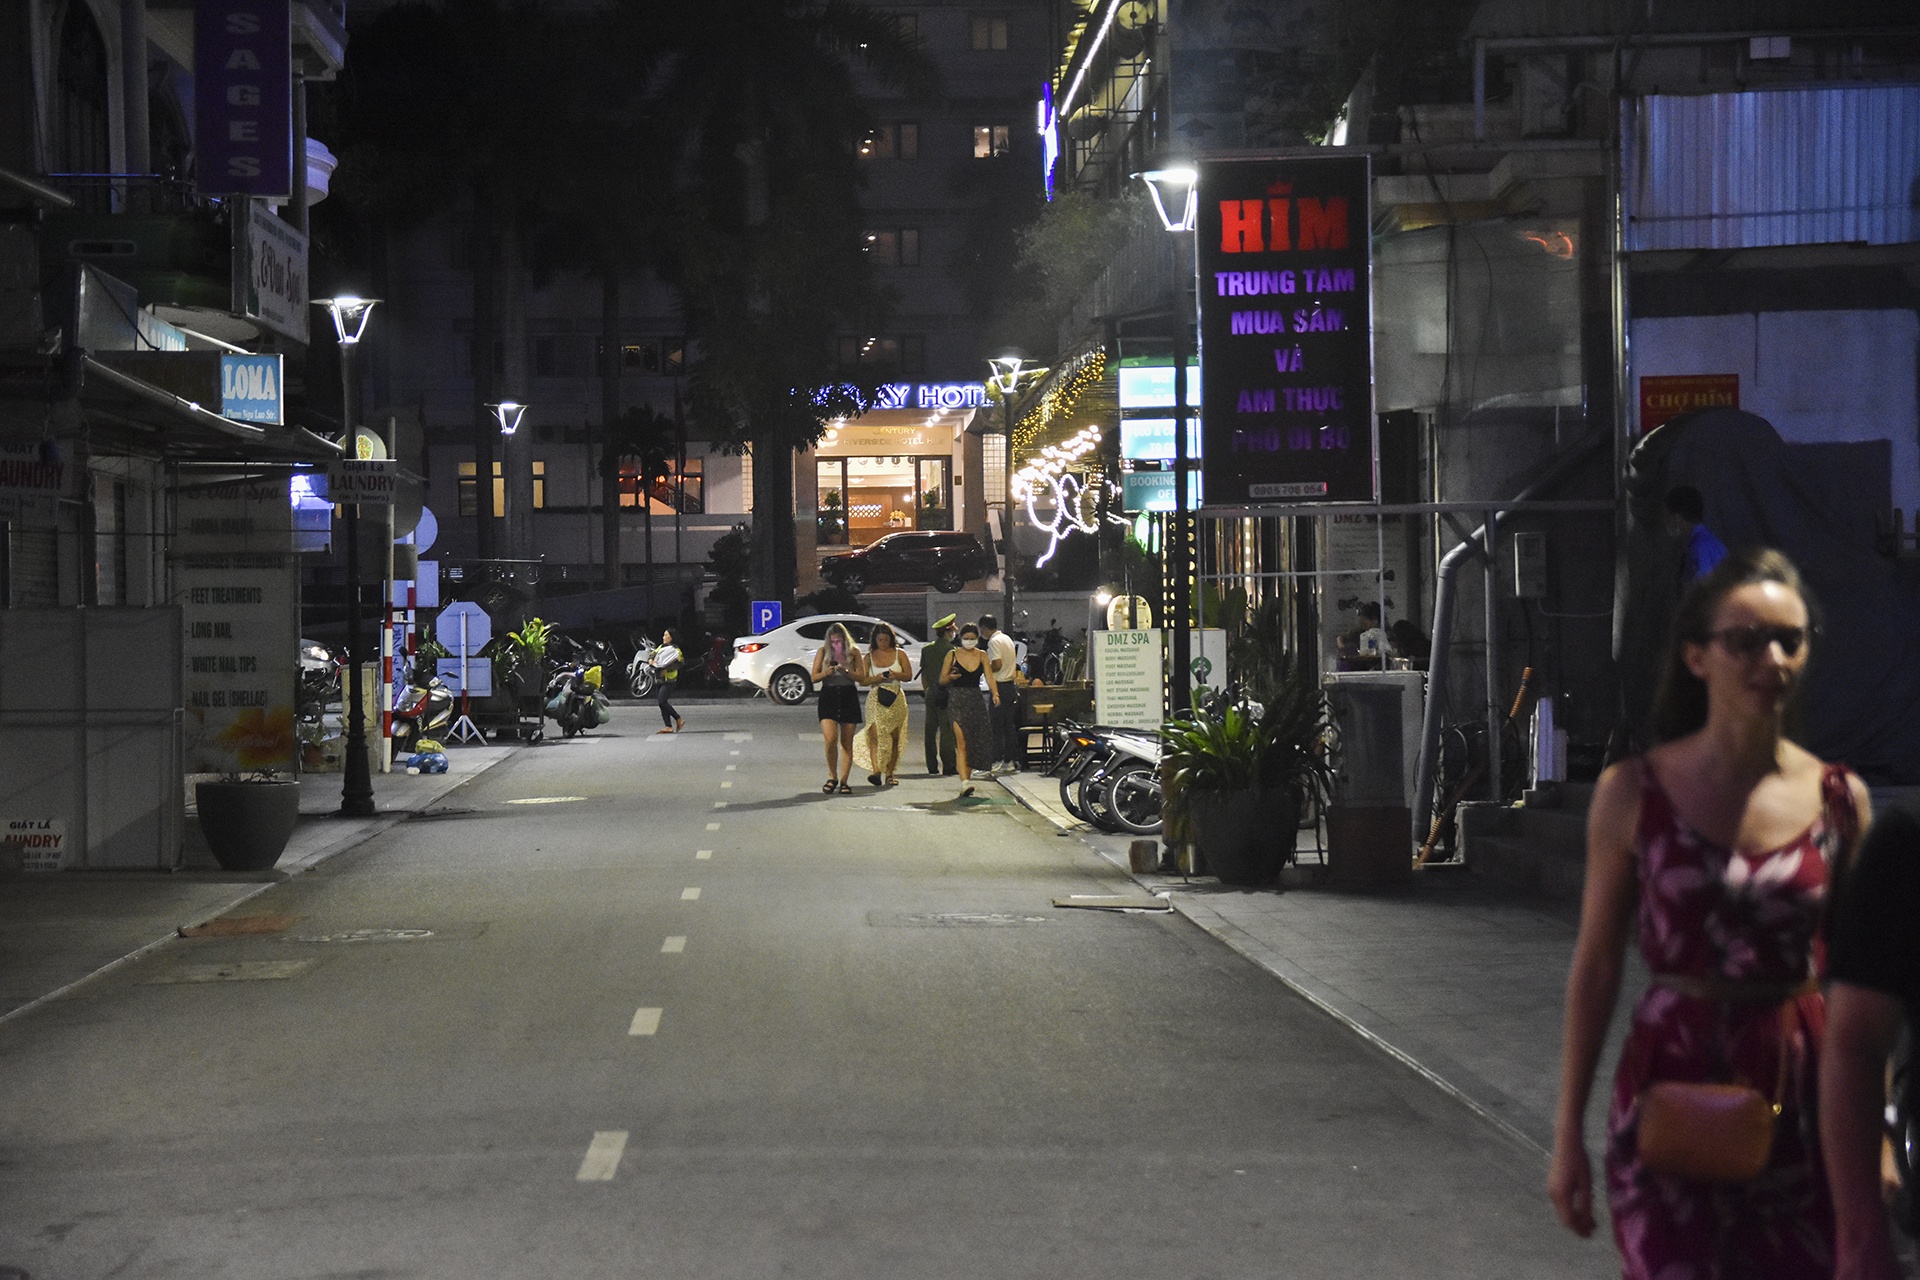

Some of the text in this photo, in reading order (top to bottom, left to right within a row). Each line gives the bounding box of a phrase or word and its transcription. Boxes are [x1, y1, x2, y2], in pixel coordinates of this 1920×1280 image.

[1215, 270, 1296, 296] TRUNG
[1230, 310, 1285, 335] MUA
[223, 365, 277, 400] LOMA
[331, 474, 396, 491] LAUNDRY
[191, 587, 262, 604] FEET TREATMENTS
[761, 608, 773, 628] P
[192, 622, 233, 639] LONG NAIL
[1107, 632, 1150, 645] DMZ SPA
[193, 656, 257, 673] WHITE NAIL TIPS
[192, 690, 211, 708] NAIL
[212, 690, 228, 708] GEL
